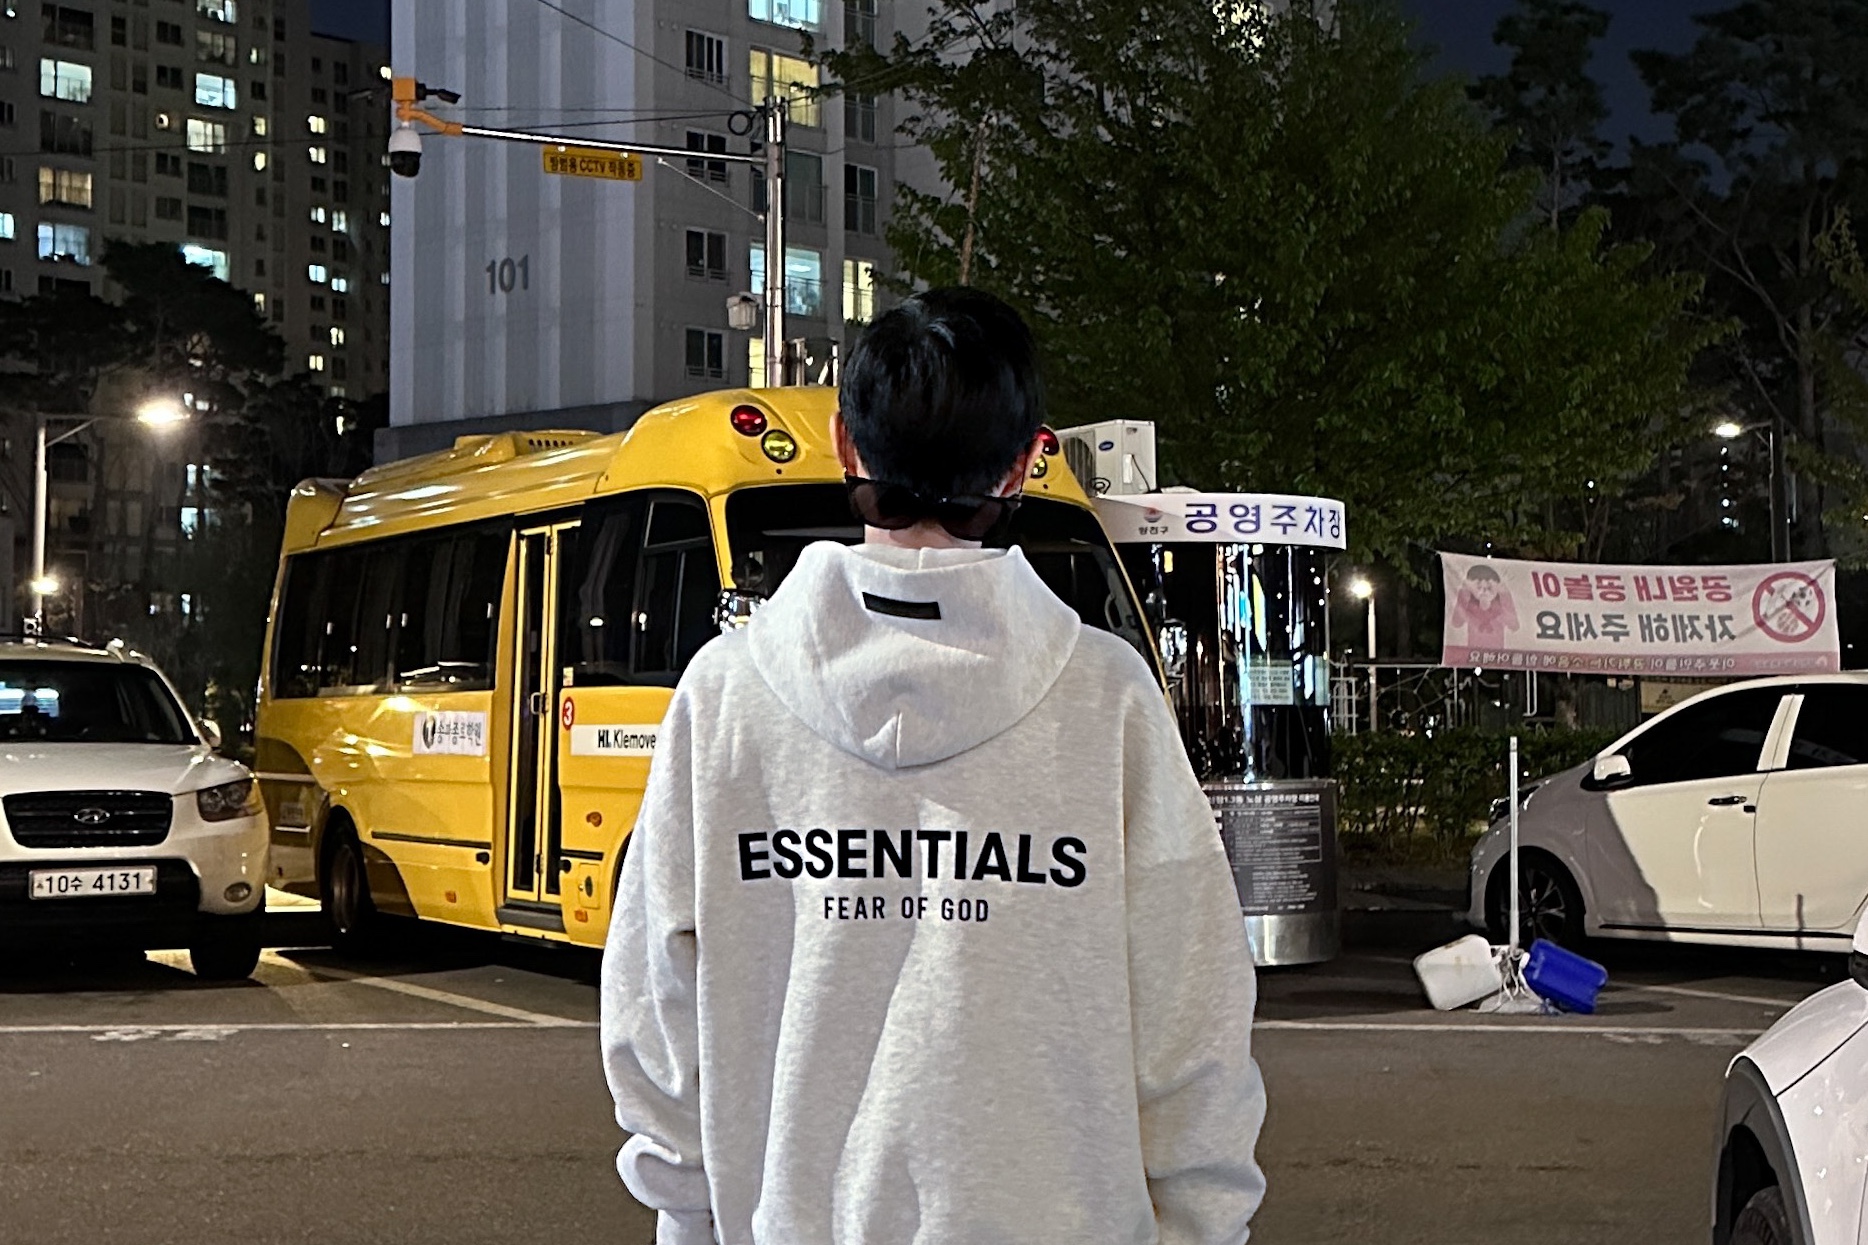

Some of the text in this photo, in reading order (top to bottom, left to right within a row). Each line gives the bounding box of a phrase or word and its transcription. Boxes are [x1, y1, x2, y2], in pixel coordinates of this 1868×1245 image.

[580, 158, 606, 173] CCTV
[486, 254, 529, 294] 101
[1185, 503, 1341, 539] 공영주차장
[563, 701, 573, 726] 3
[613, 729, 657, 749] Klemove
[738, 829, 1087, 888] ESSENTIALS
[45, 872, 141, 894] 10수 4131
[824, 896, 989, 923] FEAR OF GOD
